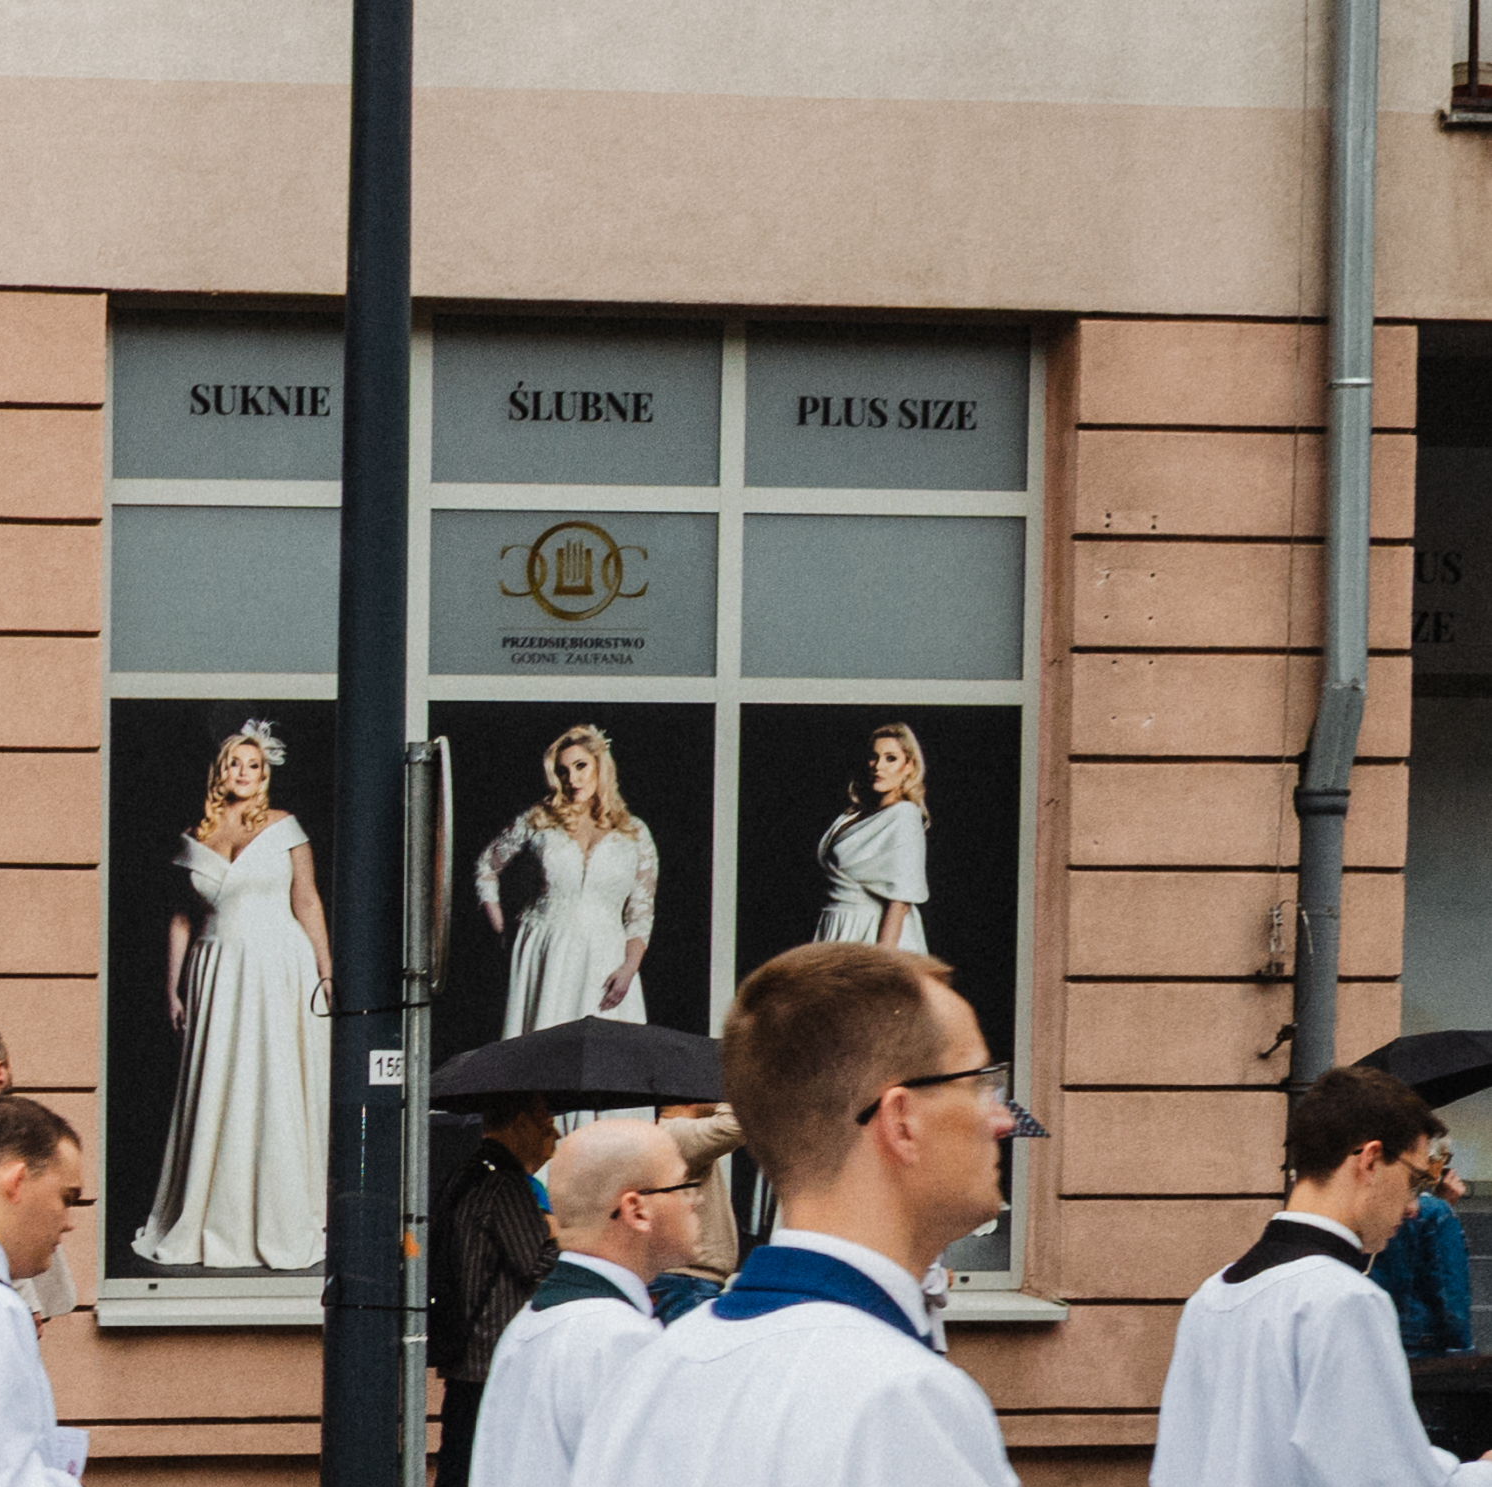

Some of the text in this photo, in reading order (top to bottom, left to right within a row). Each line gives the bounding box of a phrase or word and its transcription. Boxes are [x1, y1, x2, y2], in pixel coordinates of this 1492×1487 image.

[190, 380, 978, 431] SUKNIE ŚLUBNE PLUS SIZE
[1416, 551, 1462, 585] US
[501, 636, 646, 651] PRZEDSIĘBIORSTWO
[1413, 610, 1455, 644] ZE
[510, 651, 634, 665] GODNE ZAUFANIA
